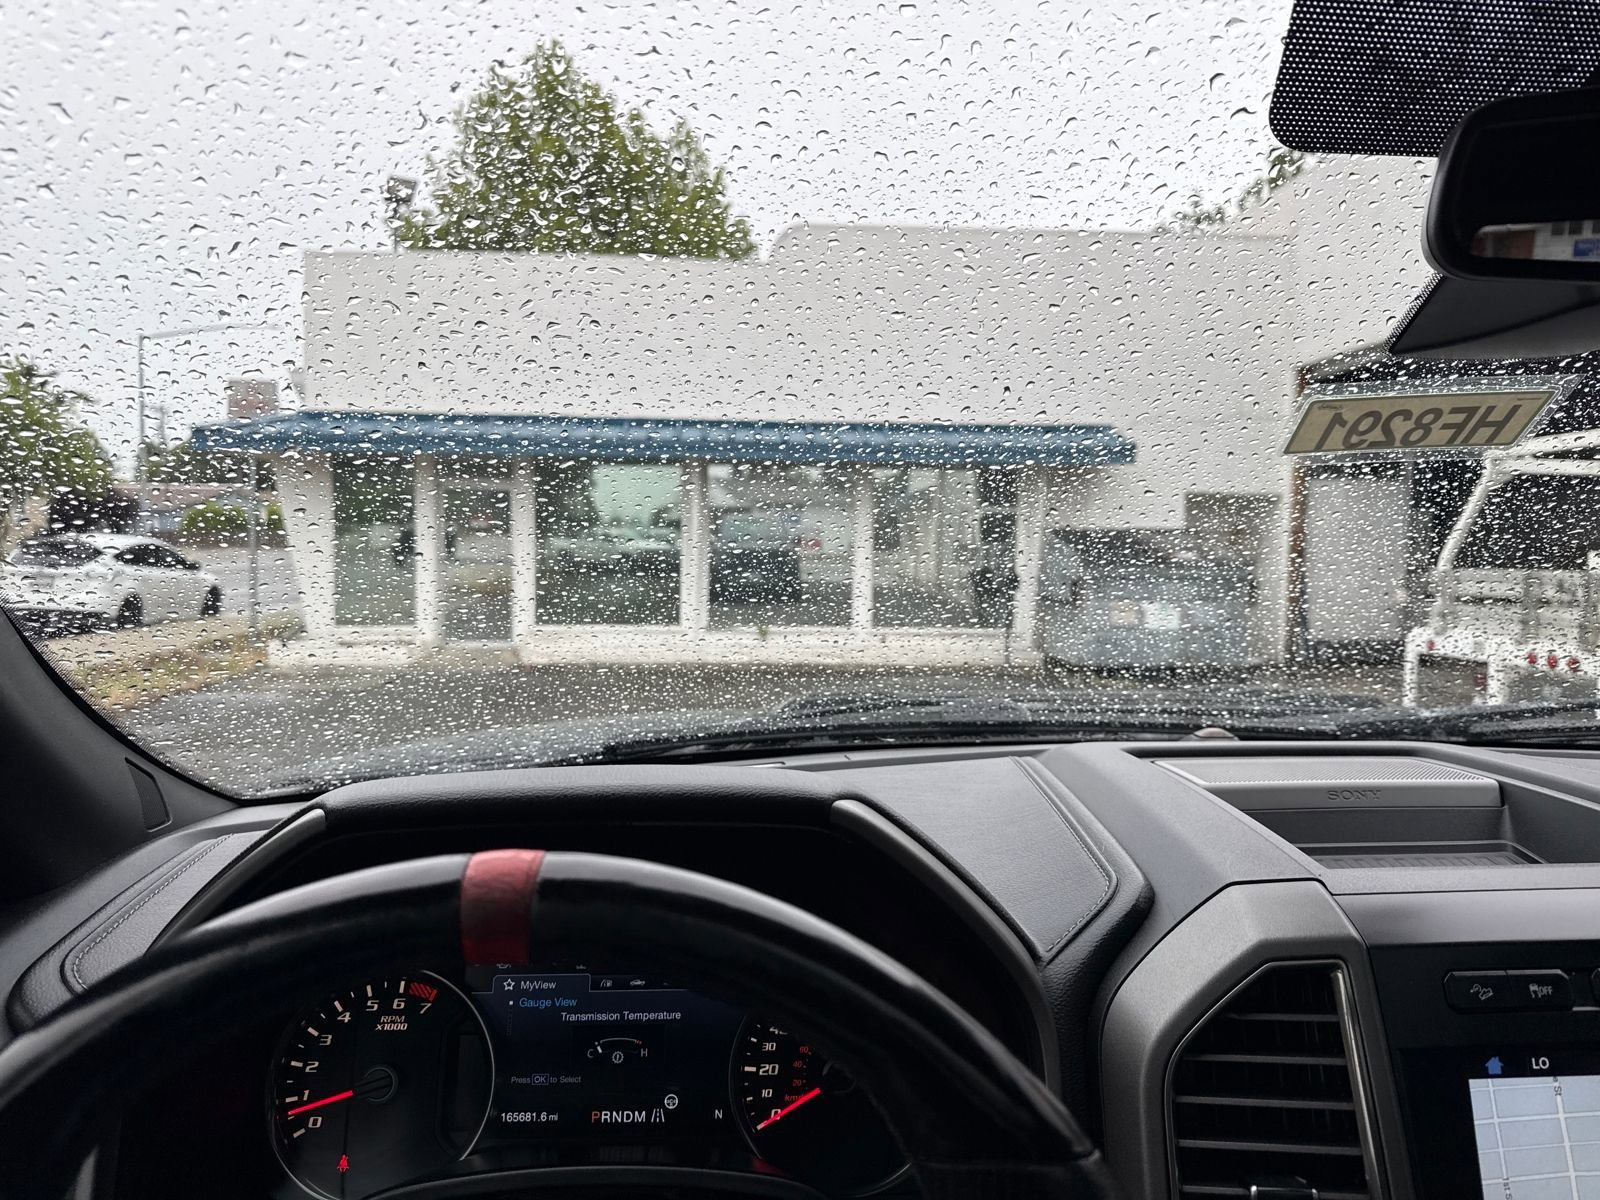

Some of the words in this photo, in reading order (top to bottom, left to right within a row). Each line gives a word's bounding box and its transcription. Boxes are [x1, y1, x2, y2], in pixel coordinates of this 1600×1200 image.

[1327, 789, 1381, 801] SONY
[520, 980, 557, 992] MyView
[366, 1000, 379, 1012] 5
[392, 998, 405, 1010] 6
[419, 1003, 432, 1015] 7
[519, 997, 552, 1009] Gauge
[554, 997, 578, 1007] View
[337, 1012, 351, 1023] 4
[380, 1015, 405, 1023] RPM
[561, 1012, 620, 1021] Transmission
[623, 1011, 682, 1022] Temperature
[319, 1034, 332, 1046] 3
[640, 1048, 648, 1058] H
[761, 1042, 777, 1052] 30
[305, 1061, 319, 1073] 2
[759, 1063, 779, 1076] 20
[1531, 1057, 1550, 1070] LO
[511, 1076, 531, 1084] Press
[533, 1075, 547, 1084] OK
[560, 1075, 582, 1084] Select
[302, 1089, 310, 1101] 1
[761, 1089, 773, 1098] 10
[501, 1111, 547, 1122] 165681.6
[548, 1112, 559, 1122] mi
[715, 1109, 723, 1120] N
[308, 1116, 323, 1129] 0
